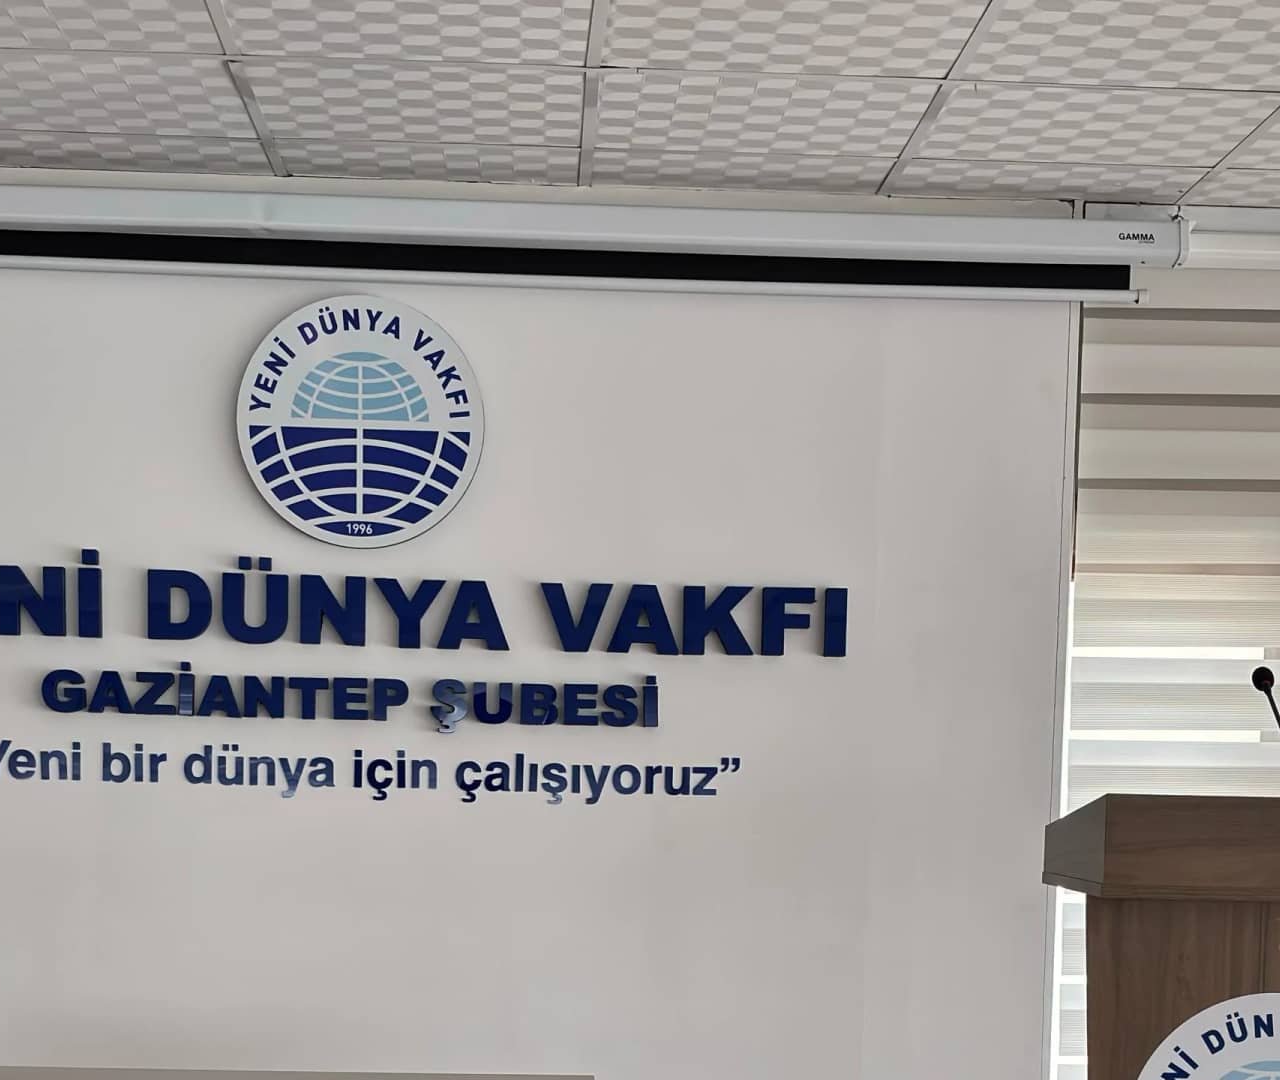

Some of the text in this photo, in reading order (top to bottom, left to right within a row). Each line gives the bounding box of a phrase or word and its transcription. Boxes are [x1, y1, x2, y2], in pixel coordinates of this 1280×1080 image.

[1118, 232, 1156, 241] GAMMA
[249, 306, 471, 419] YENİ DÜNYA VAKFI
[345, 522, 374, 536] 1996
[147, 556, 510, 651] DÜNYA
[539, 581, 849, 658] VAKFI
[40, 661, 660, 734] GAZİANTEP ŞUBESİ
[101, 742, 168, 785] bir
[182, 744, 335, 799] dünya
[352, 749, 438, 801] için
[453, 753, 741, 806] çalışıyoruz”
